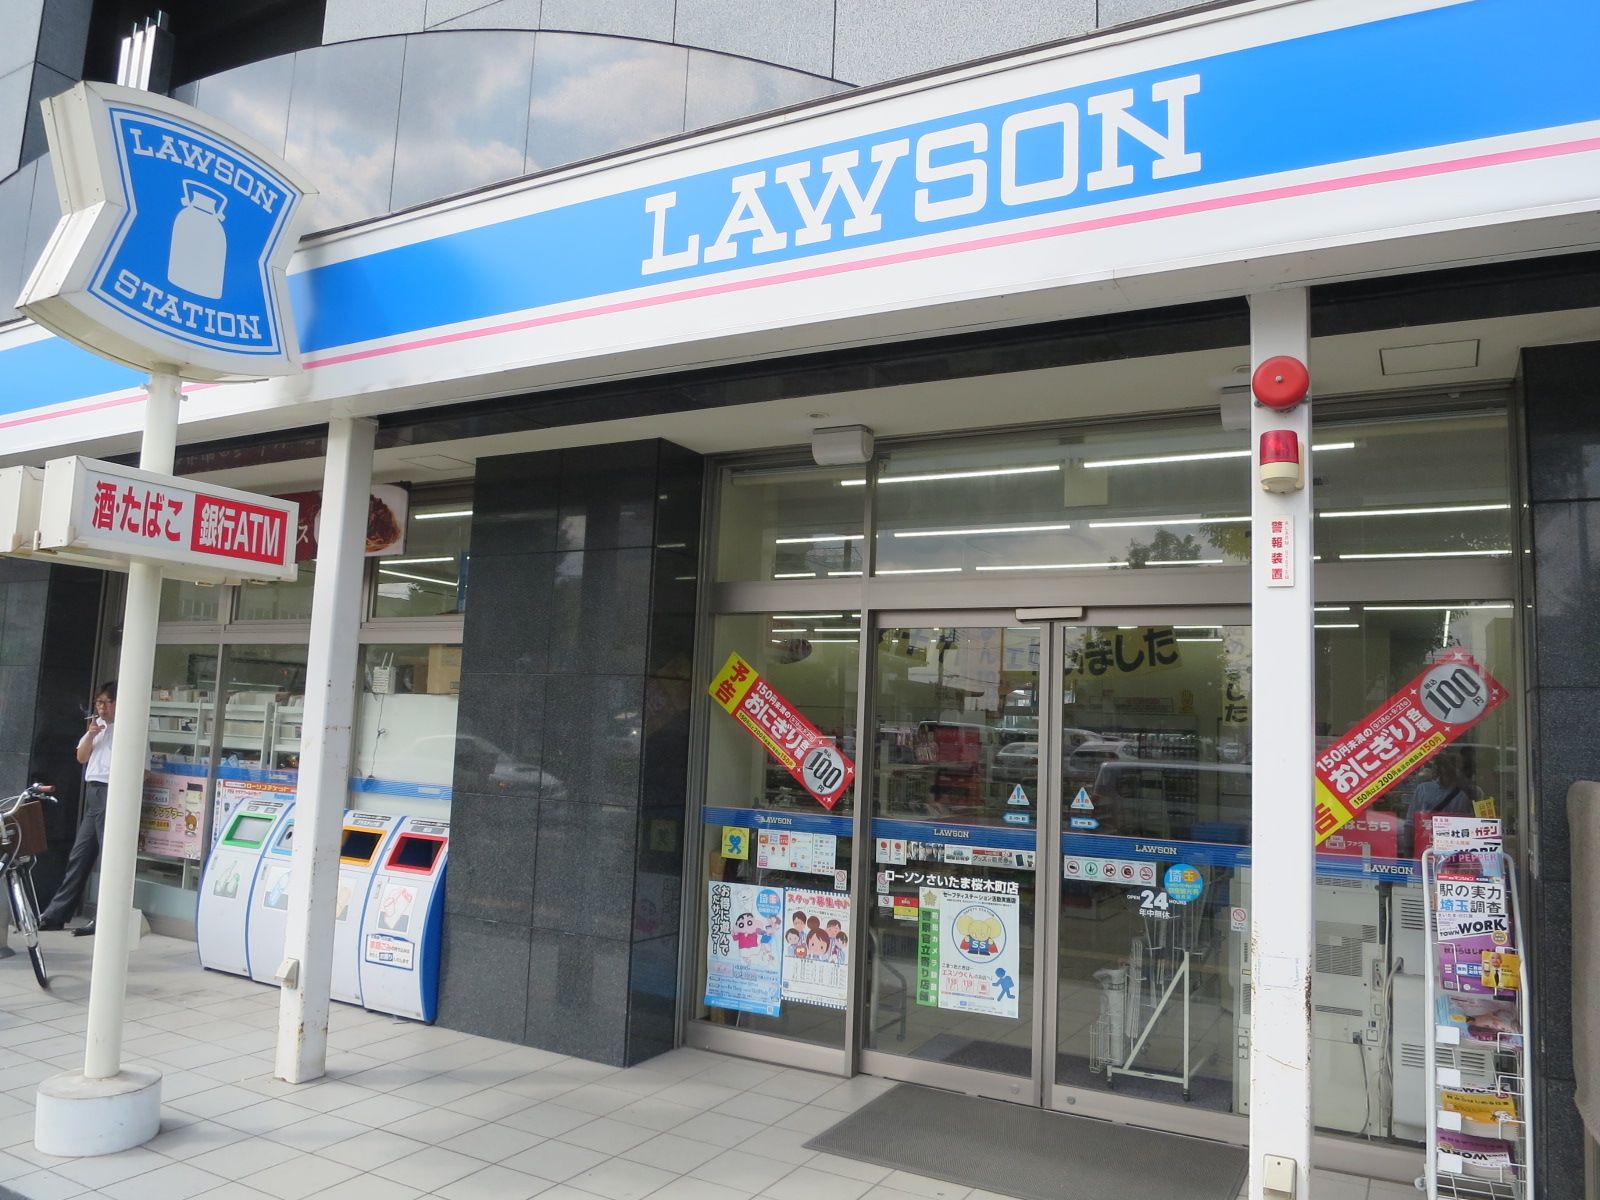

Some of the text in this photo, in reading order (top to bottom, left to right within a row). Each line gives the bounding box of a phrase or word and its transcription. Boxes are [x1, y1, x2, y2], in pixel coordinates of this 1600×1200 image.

[129, 127, 278, 214] LAWSON
[641, 73, 1202, 276] LAWSON
[114, 268, 262, 340] STATION
[91, 479, 184, 543] 酒・たばこ
[199, 502, 284, 558] 銀行ATM
[1271, 521, 1283, 580] 警報装置
[714, 659, 751, 705] 予告
[1425, 668, 1481, 720] 100
[1472, 696, 1485, 708] 円
[1315, 727, 1373, 773] 150円未満の
[805, 750, 842, 789] 100
[933, 828, 970, 839] LAWSON
[1450, 828, 1470, 838] 社員
[1475, 825, 1498, 837] ガテン
[1135, 844, 1177, 856] LAWSON
[1458, 853, 1497, 863] PEPPER
[1362, 863, 1414, 875] LAWSON
[1140, 889, 1169, 911] 24
[1439, 883, 1502, 900] 駅の実力
[1139, 907, 1171, 920] 年中無休
[1440, 898, 1502, 914] 埼玉調査
[1457, 918, 1507, 934] WORK
[971, 940, 987, 950] SS
